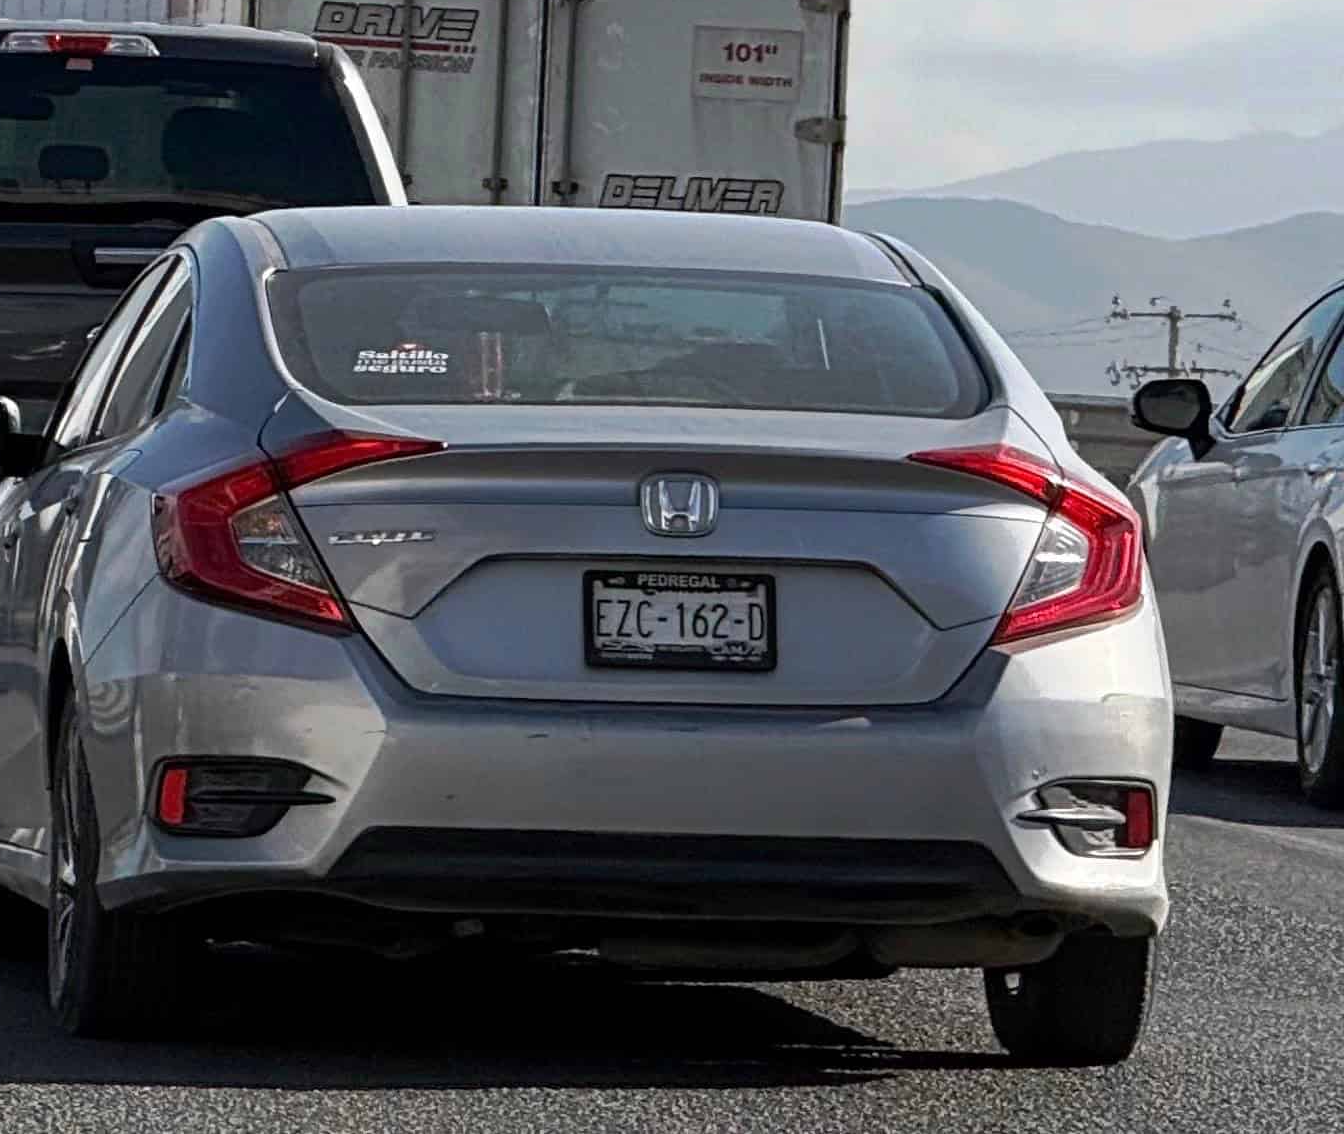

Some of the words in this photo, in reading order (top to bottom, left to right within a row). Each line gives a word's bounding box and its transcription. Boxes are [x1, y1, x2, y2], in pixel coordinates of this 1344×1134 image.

[314, 1, 480, 42] DRIVE
[598, 173, 784, 213] DELIVER
[638, 573, 720, 588] PEDREGAL
[596, 599, 765, 641] EZC-162-D
